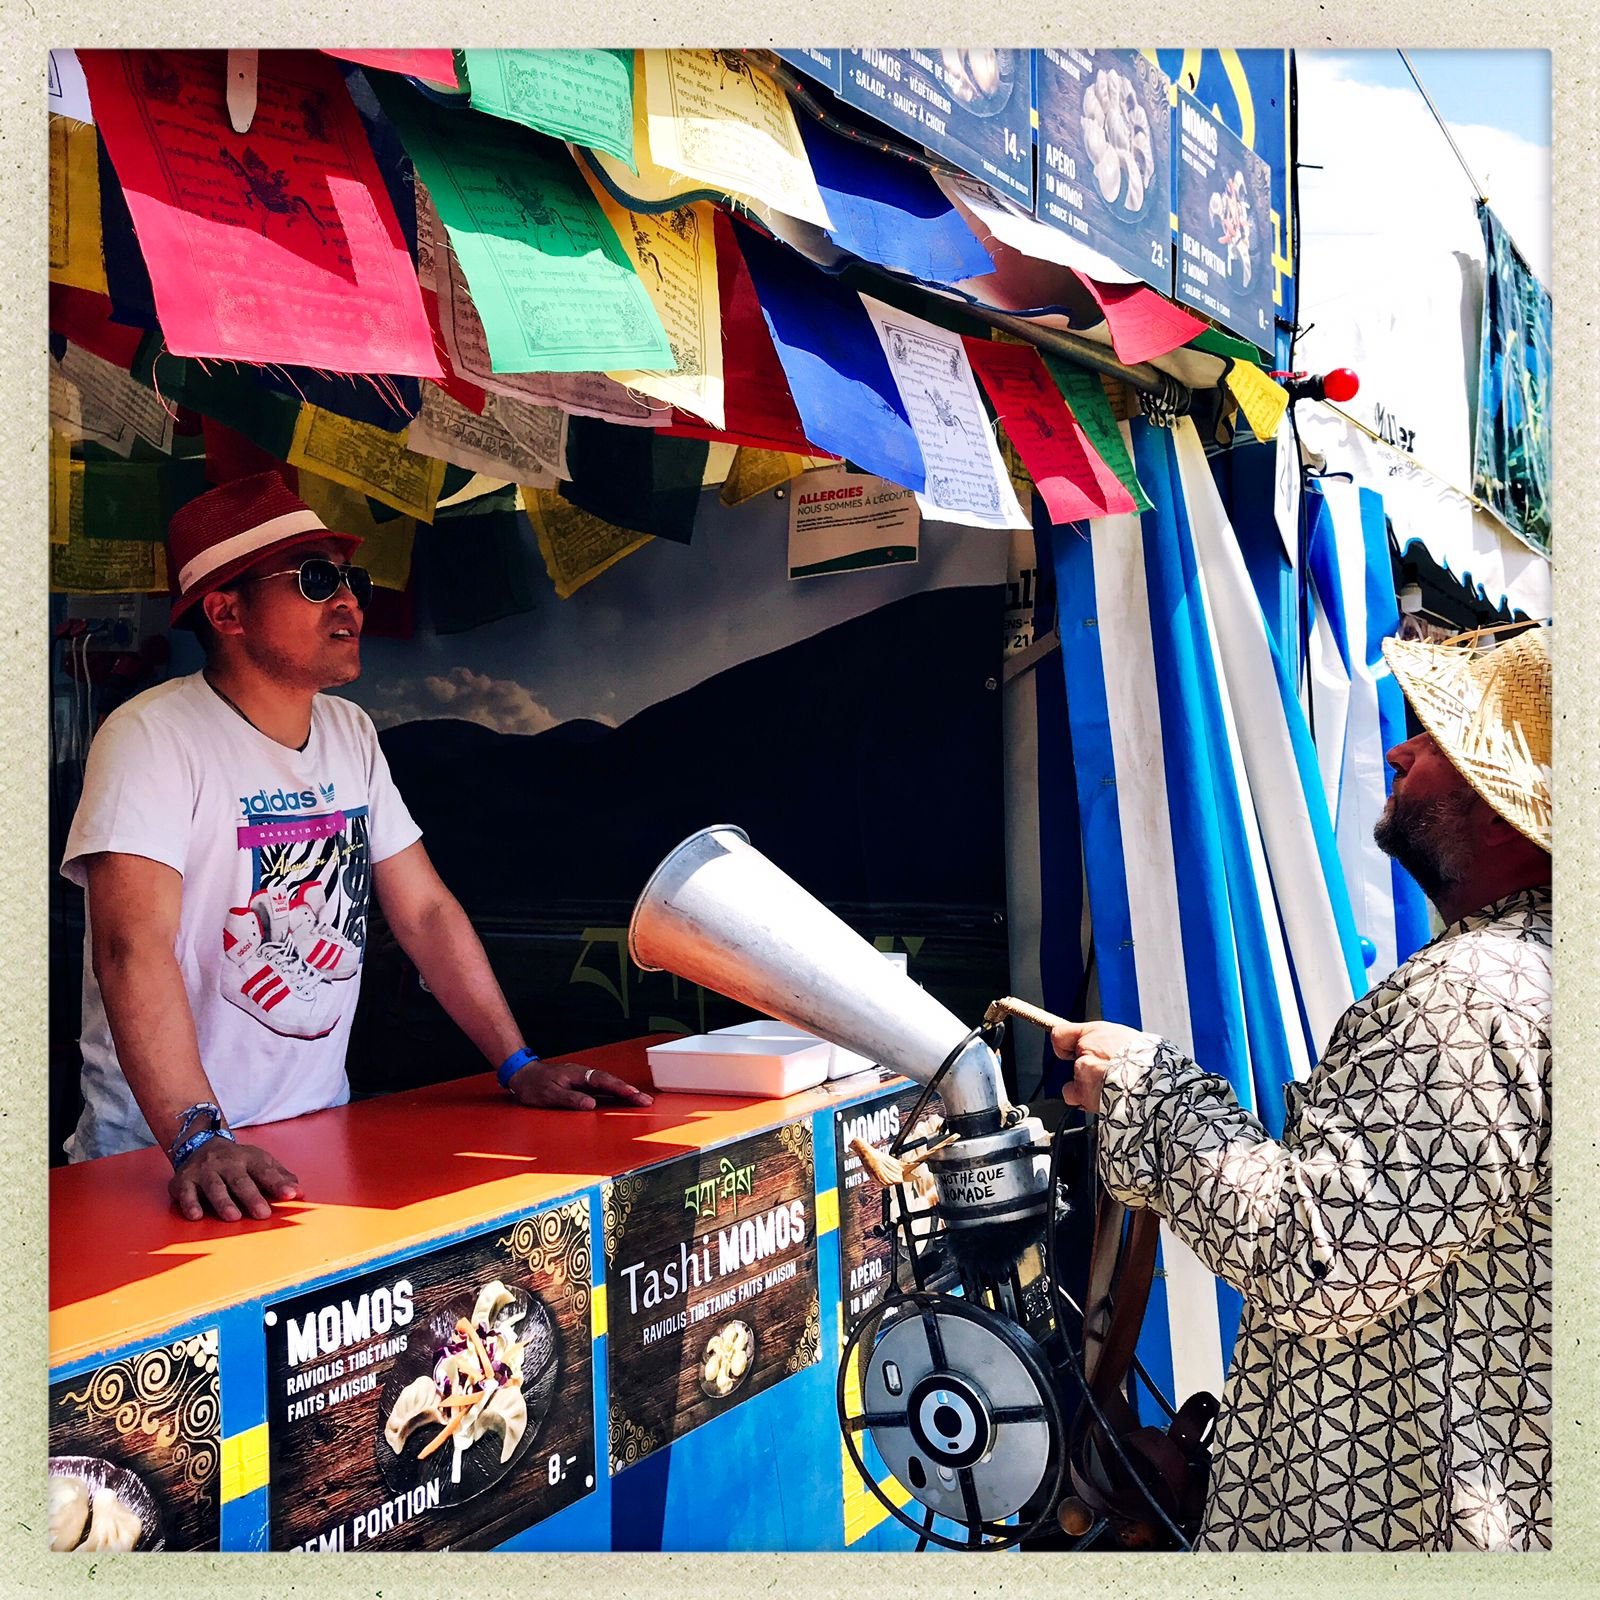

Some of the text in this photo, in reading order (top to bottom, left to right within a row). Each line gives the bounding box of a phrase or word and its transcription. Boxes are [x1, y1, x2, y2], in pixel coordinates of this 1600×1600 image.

[861, 48, 901, 82] MOMOS
[855, 69, 887, 100] SALADE
[893, 91, 918, 119] SAUCE
[918, 104, 925, 123] À
[925, 112, 946, 137] CHOIX
[909, 76, 952, 115] VÉGÉTARIENS
[1003, 127, 1027, 163] 14.-
[1181, 99, 1218, 157] MOMOS
[1045, 143, 1076, 180] APÉRO
[1045, 172, 1055, 193] 10
[1055, 179, 1084, 211] MOMOS
[1049, 202, 1069, 223] SAUCE
[1151, 240, 1170, 270] 23.-
[1182, 232, 1201, 260] DEMI
[797, 489, 914, 516] NOUS SOMMES À L'ÉCOUTE
[798, 486, 864, 505] ALLERGIES
[842, 1104, 901, 1154] MOMOS
[845, 1172, 863, 1190] FAITS
[943, 1185, 996, 1204] NOMADE
[620, 1199, 806, 1316] Tashi MOMOS
[849, 1257, 883, 1292] APÉRO
[643, 1260, 797, 1346] RAVIOLIS TIBÉTAINS FAITS MAISON
[850, 1296, 861, 1316] 10
[286, 1279, 415, 1368] MOMOS
[286, 1333, 409, 1397] RAVIOLIS TIBÉTAINS
[287, 1371, 378, 1423] FAITS MAISON
[547, 1453, 578, 1487] 8.-
[289, 1476, 441, 1553] EMI PORTION
